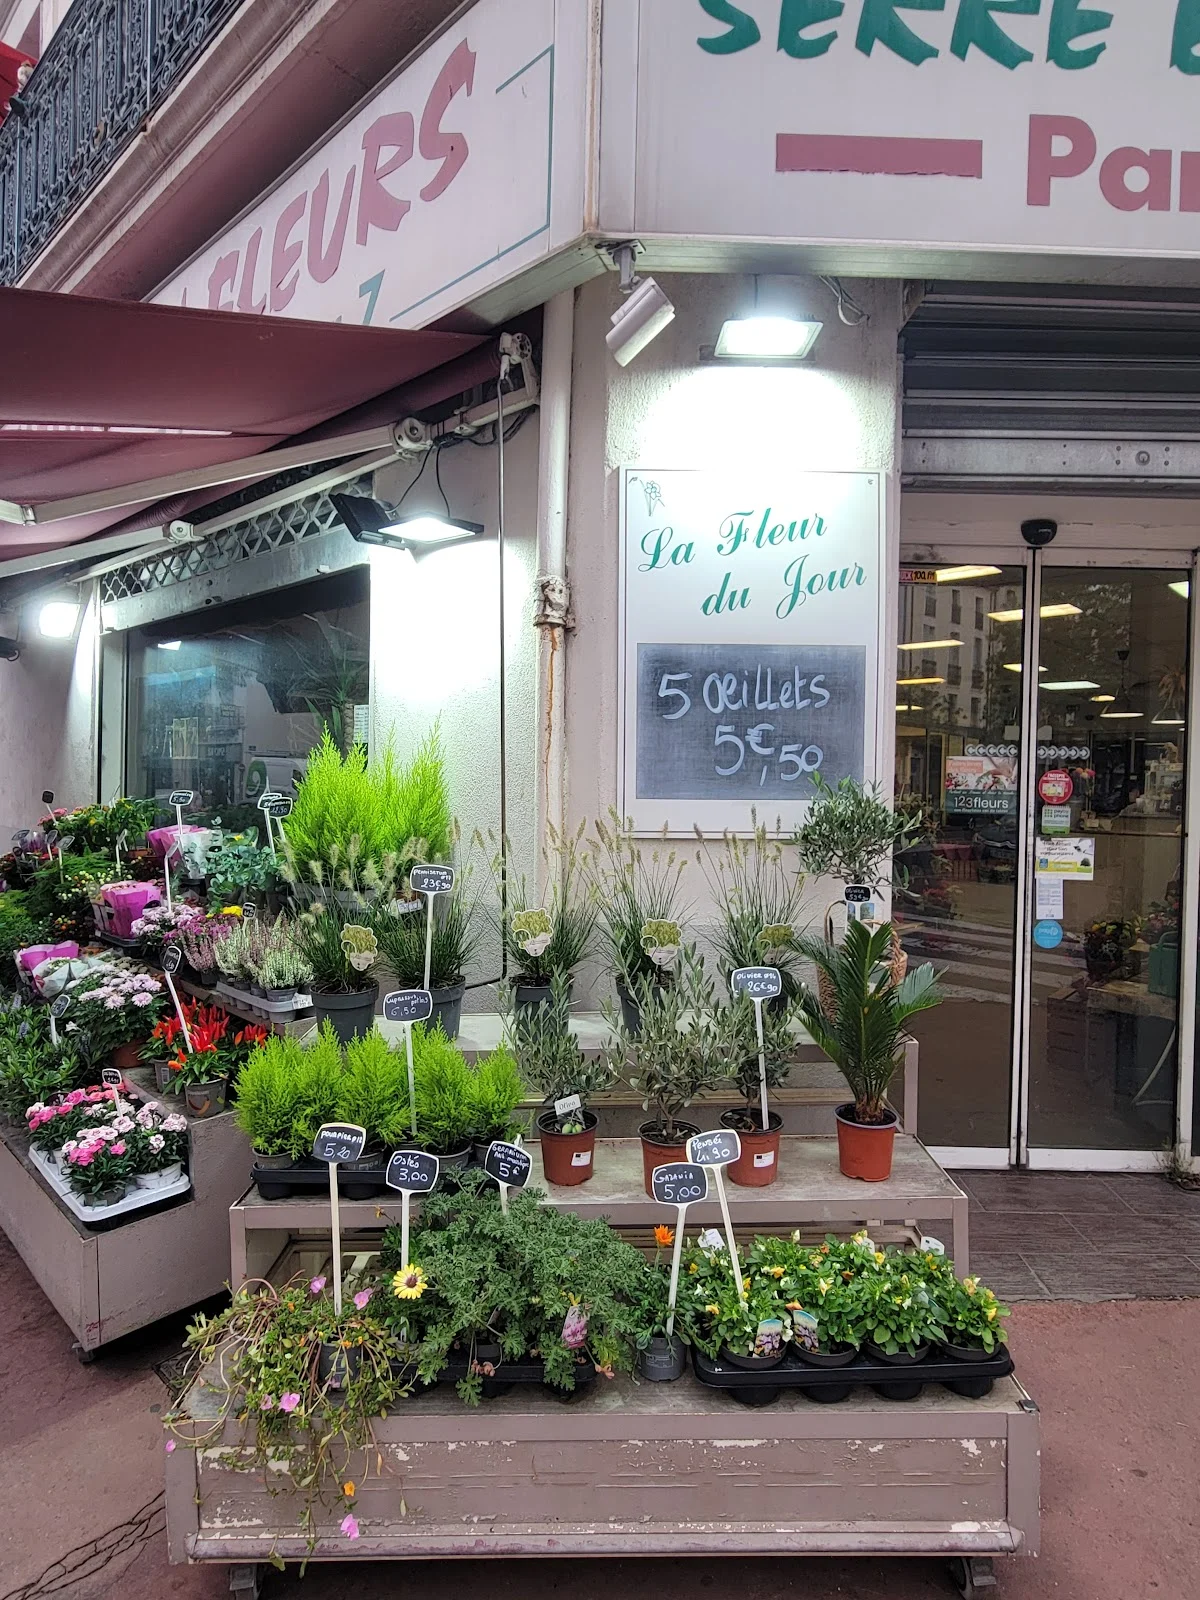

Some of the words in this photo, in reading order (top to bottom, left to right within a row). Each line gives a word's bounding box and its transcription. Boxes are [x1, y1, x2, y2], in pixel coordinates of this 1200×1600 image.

[638, 526, 696, 573] La
[716, 507, 828, 556] Fleur
[700, 571, 752, 617] du
[776, 553, 868, 620] Jour
[657, 671, 693, 720] 5
[954, 796, 1009, 809] 123fleurs
[391, 1006, 417, 1017] 6,50
[323, 1142, 351, 1159] 5,20
[398, 1167, 429, 1183] 3,00
[663, 1183, 702, 1202] 5,00
